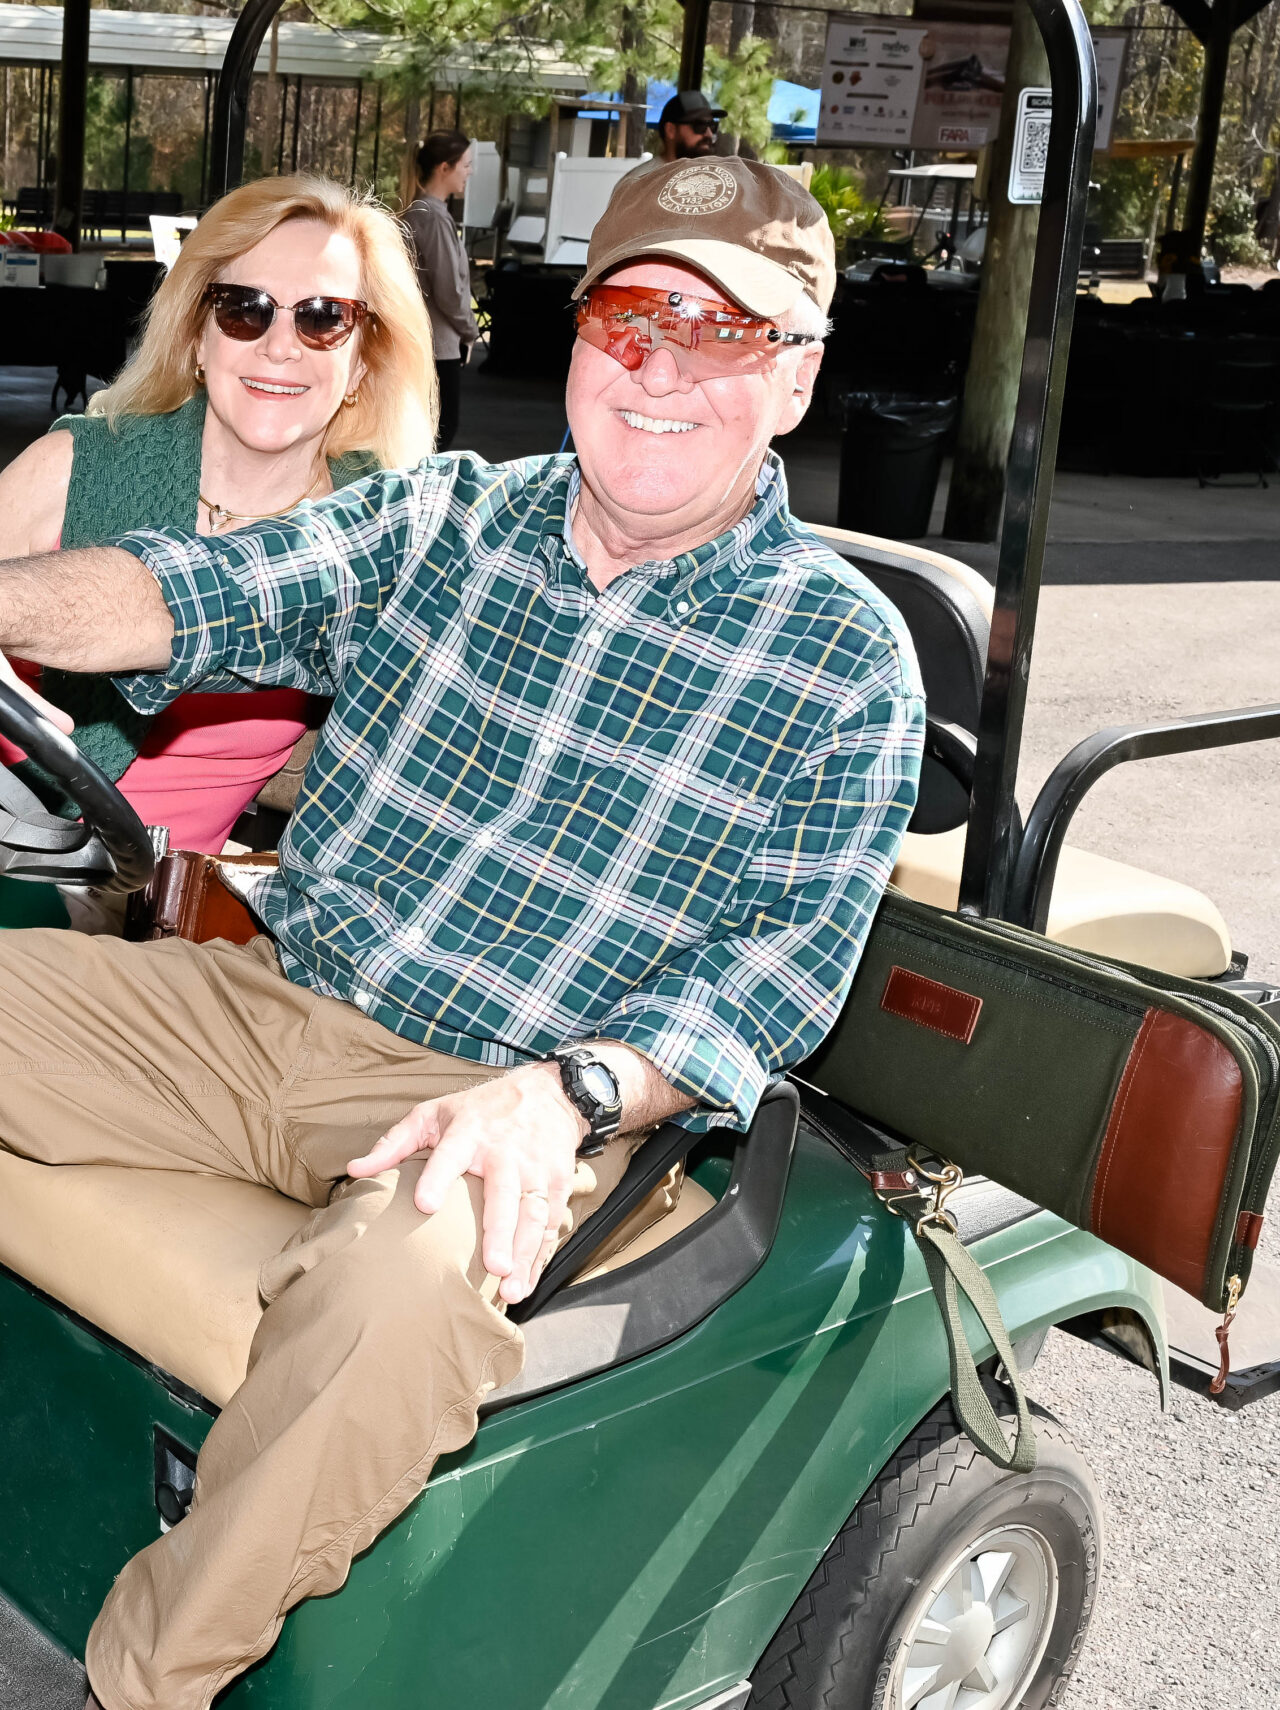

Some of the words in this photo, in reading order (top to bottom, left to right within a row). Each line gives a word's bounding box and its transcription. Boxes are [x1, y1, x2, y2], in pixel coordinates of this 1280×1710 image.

[940, 128, 969, 142] FARA
[715, 166, 734, 188] WOOD
[661, 195, 730, 213] PLANTATION
